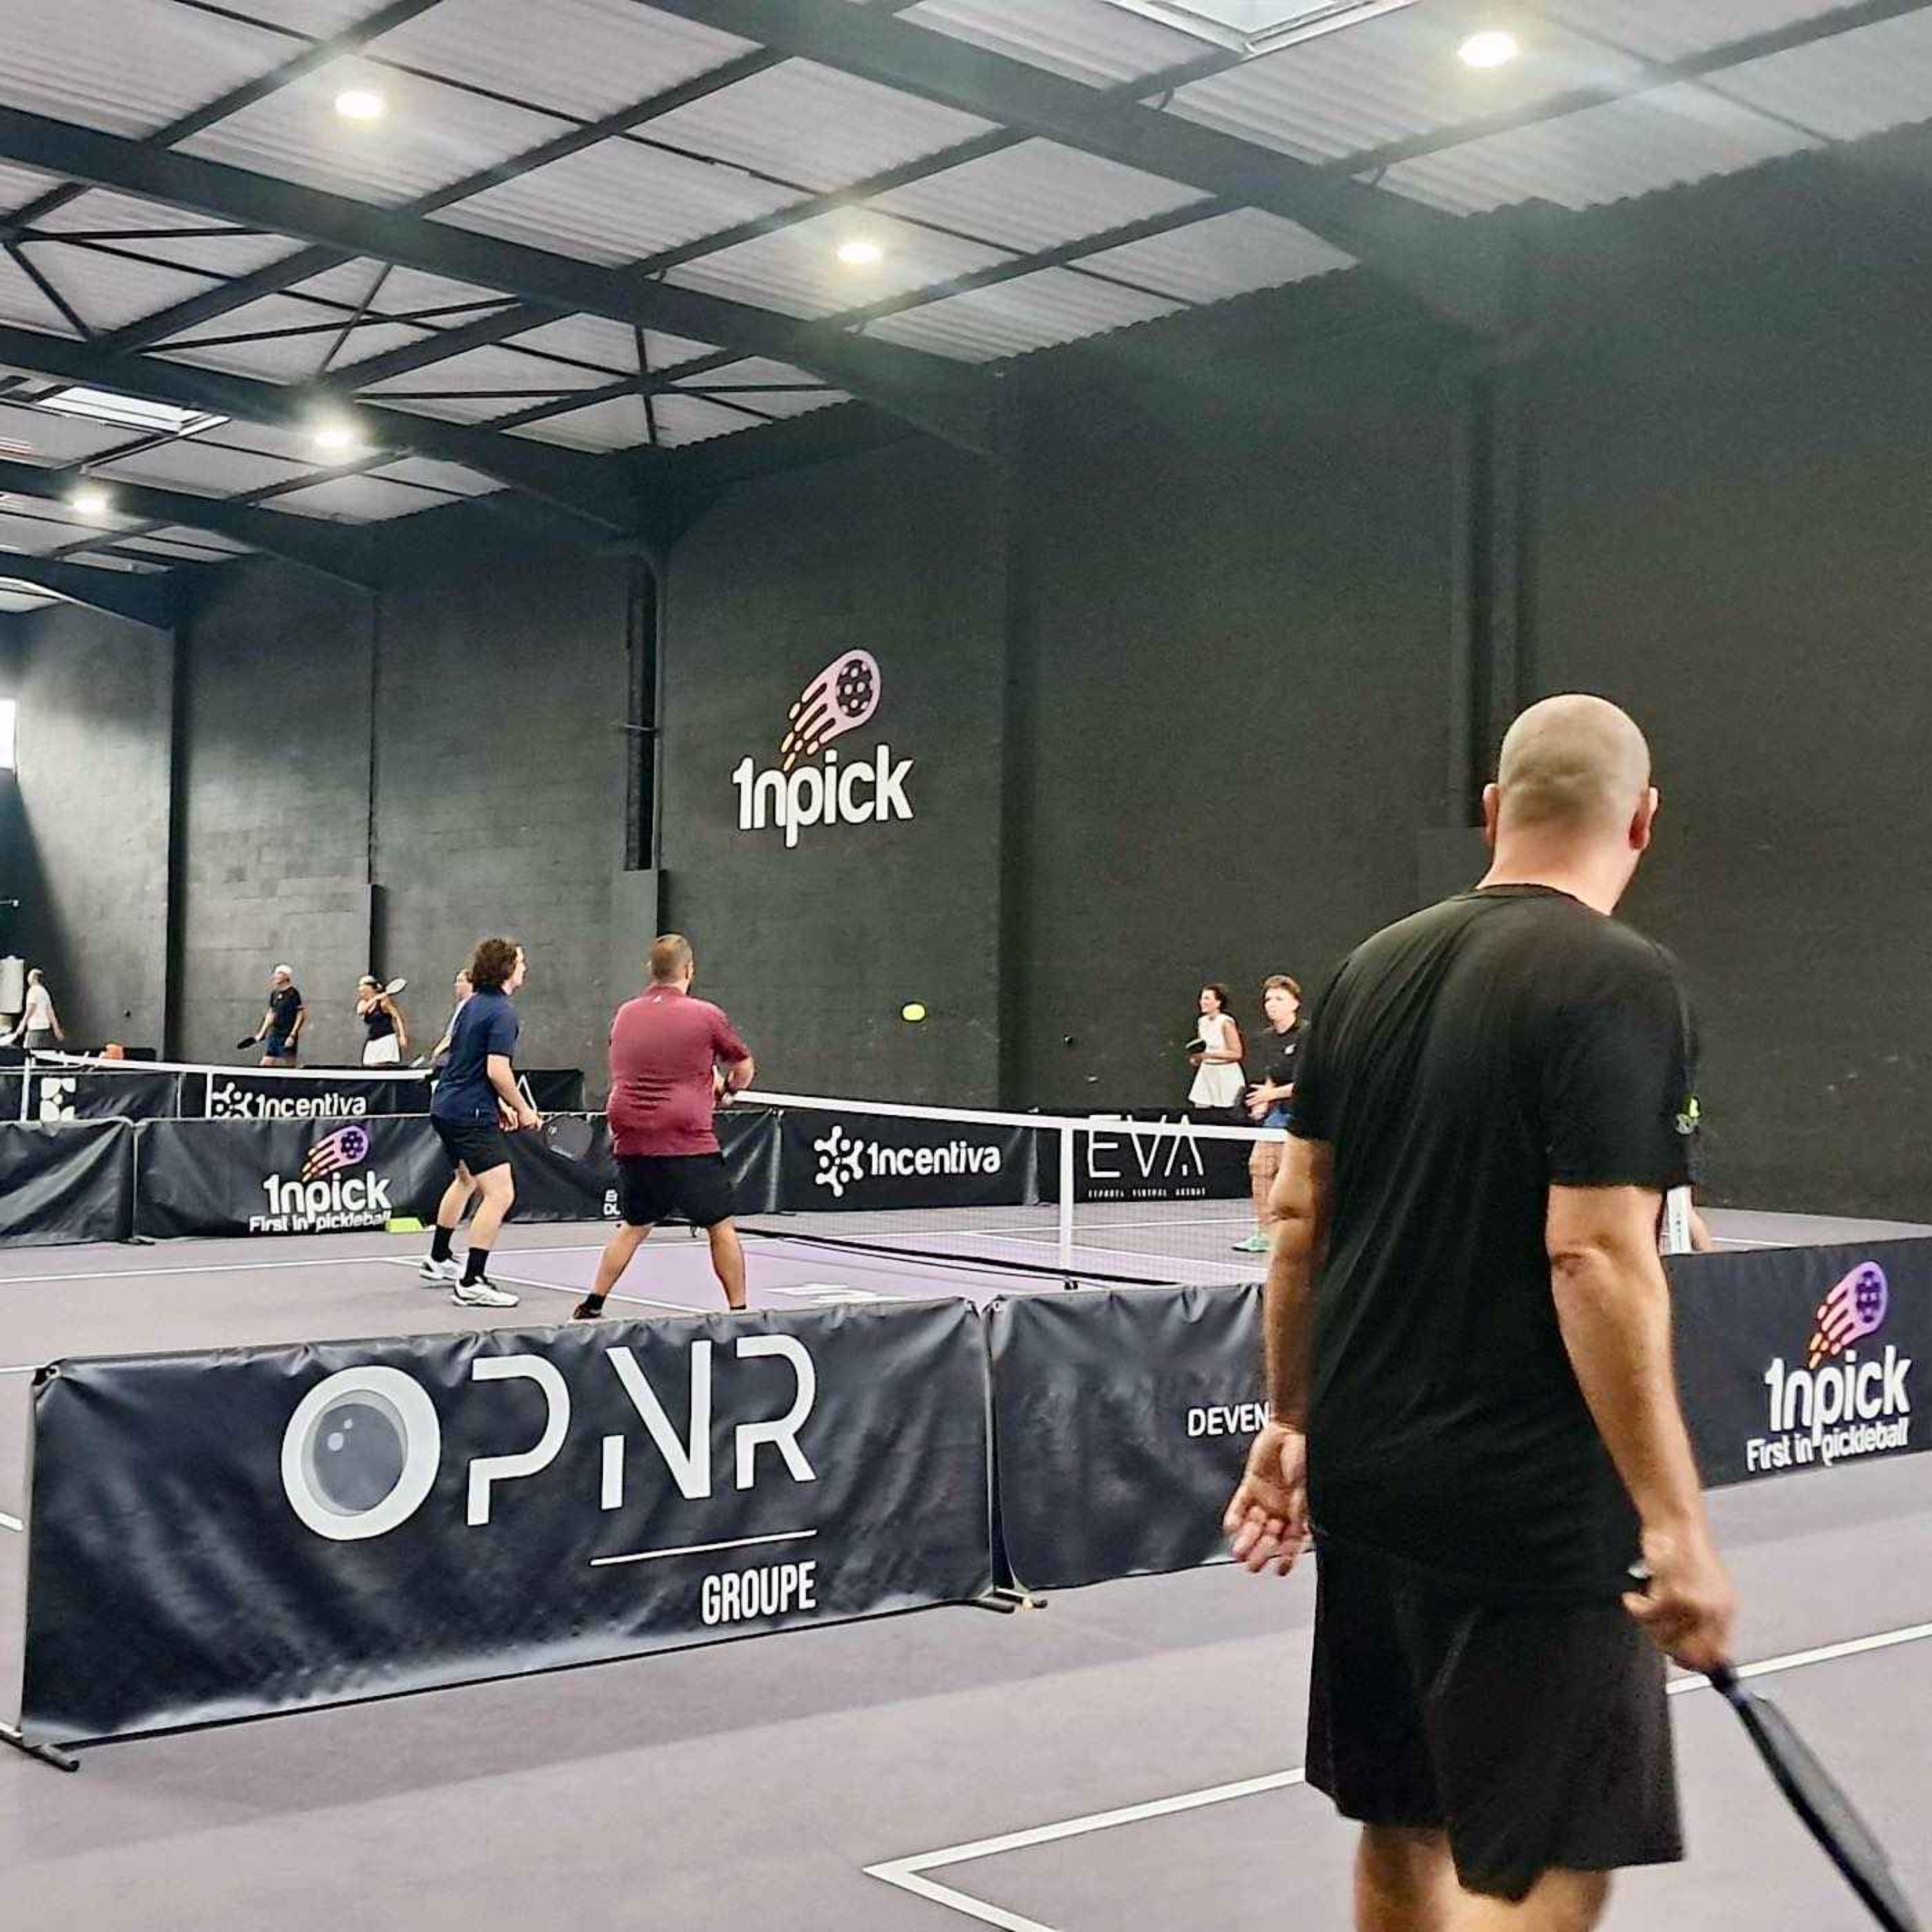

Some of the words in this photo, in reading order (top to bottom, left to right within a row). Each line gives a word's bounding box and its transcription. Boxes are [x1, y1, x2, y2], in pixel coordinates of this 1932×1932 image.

[732, 744, 914, 849] 1npick
[1087, 1115, 1204, 1178] EVA
[249, 1215, 289, 1232] First
[316, 1210, 392, 1233] pickleball
[263, 1170, 392, 1224] 1npick
[1765, 1345, 1912, 1447] 1npick
[1747, 1435, 1792, 1472] First
[1794, 1433, 1814, 1464] in
[1821, 1417, 1910, 1467] pickleball
[701, 1561, 816, 1625] GROUPE
